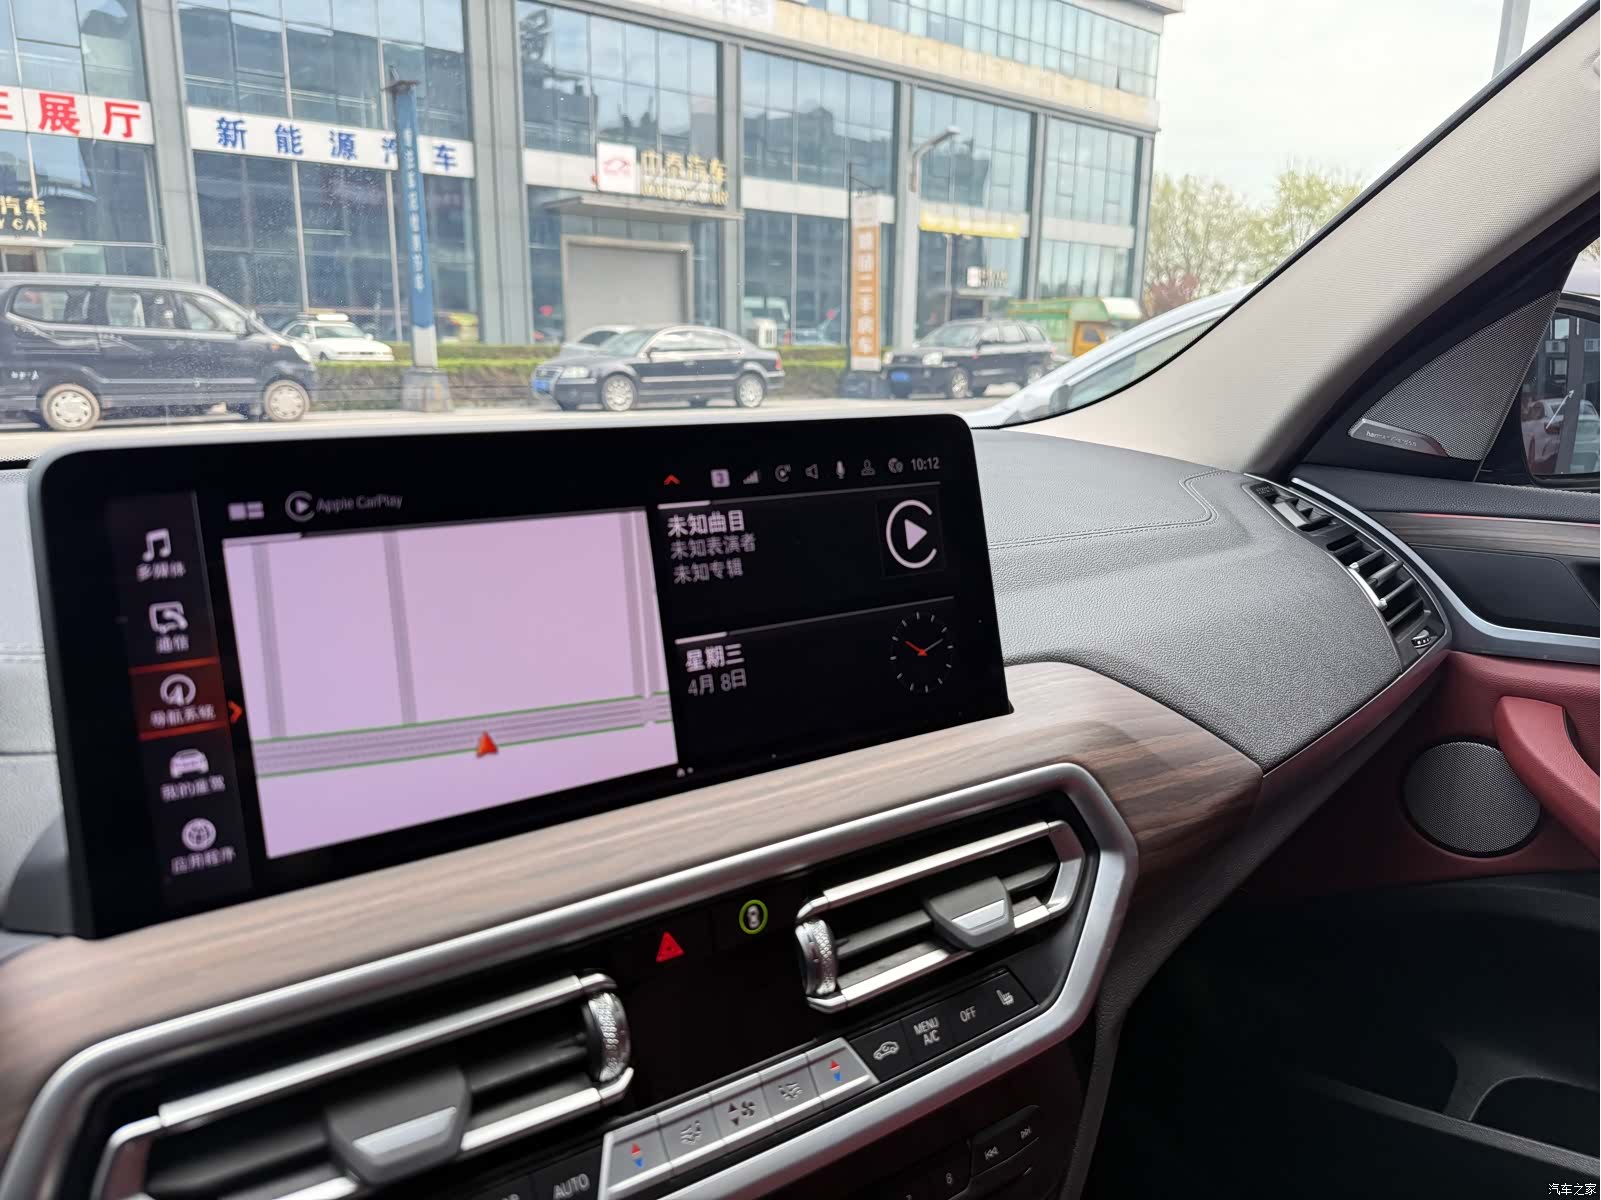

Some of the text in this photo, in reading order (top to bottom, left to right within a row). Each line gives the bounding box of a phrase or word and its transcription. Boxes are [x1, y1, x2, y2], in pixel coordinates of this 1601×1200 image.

[910, 457, 940, 472] 10:12
[667, 509, 745, 537] 未知曲目
[670, 532, 756, 560] 未知表演者
[673, 557, 743, 584] 未知专辑
[685, 643, 745, 673] 星期三
[688, 667, 747, 696] 4月 8日
[171, 846, 236, 875] 应用程序
[913, 1017, 940, 1036] MENU
[959, 1006, 976, 1023] OFF
[923, 1029, 940, 1046] A/C
[553, 1173, 590, 1200] AUTO
